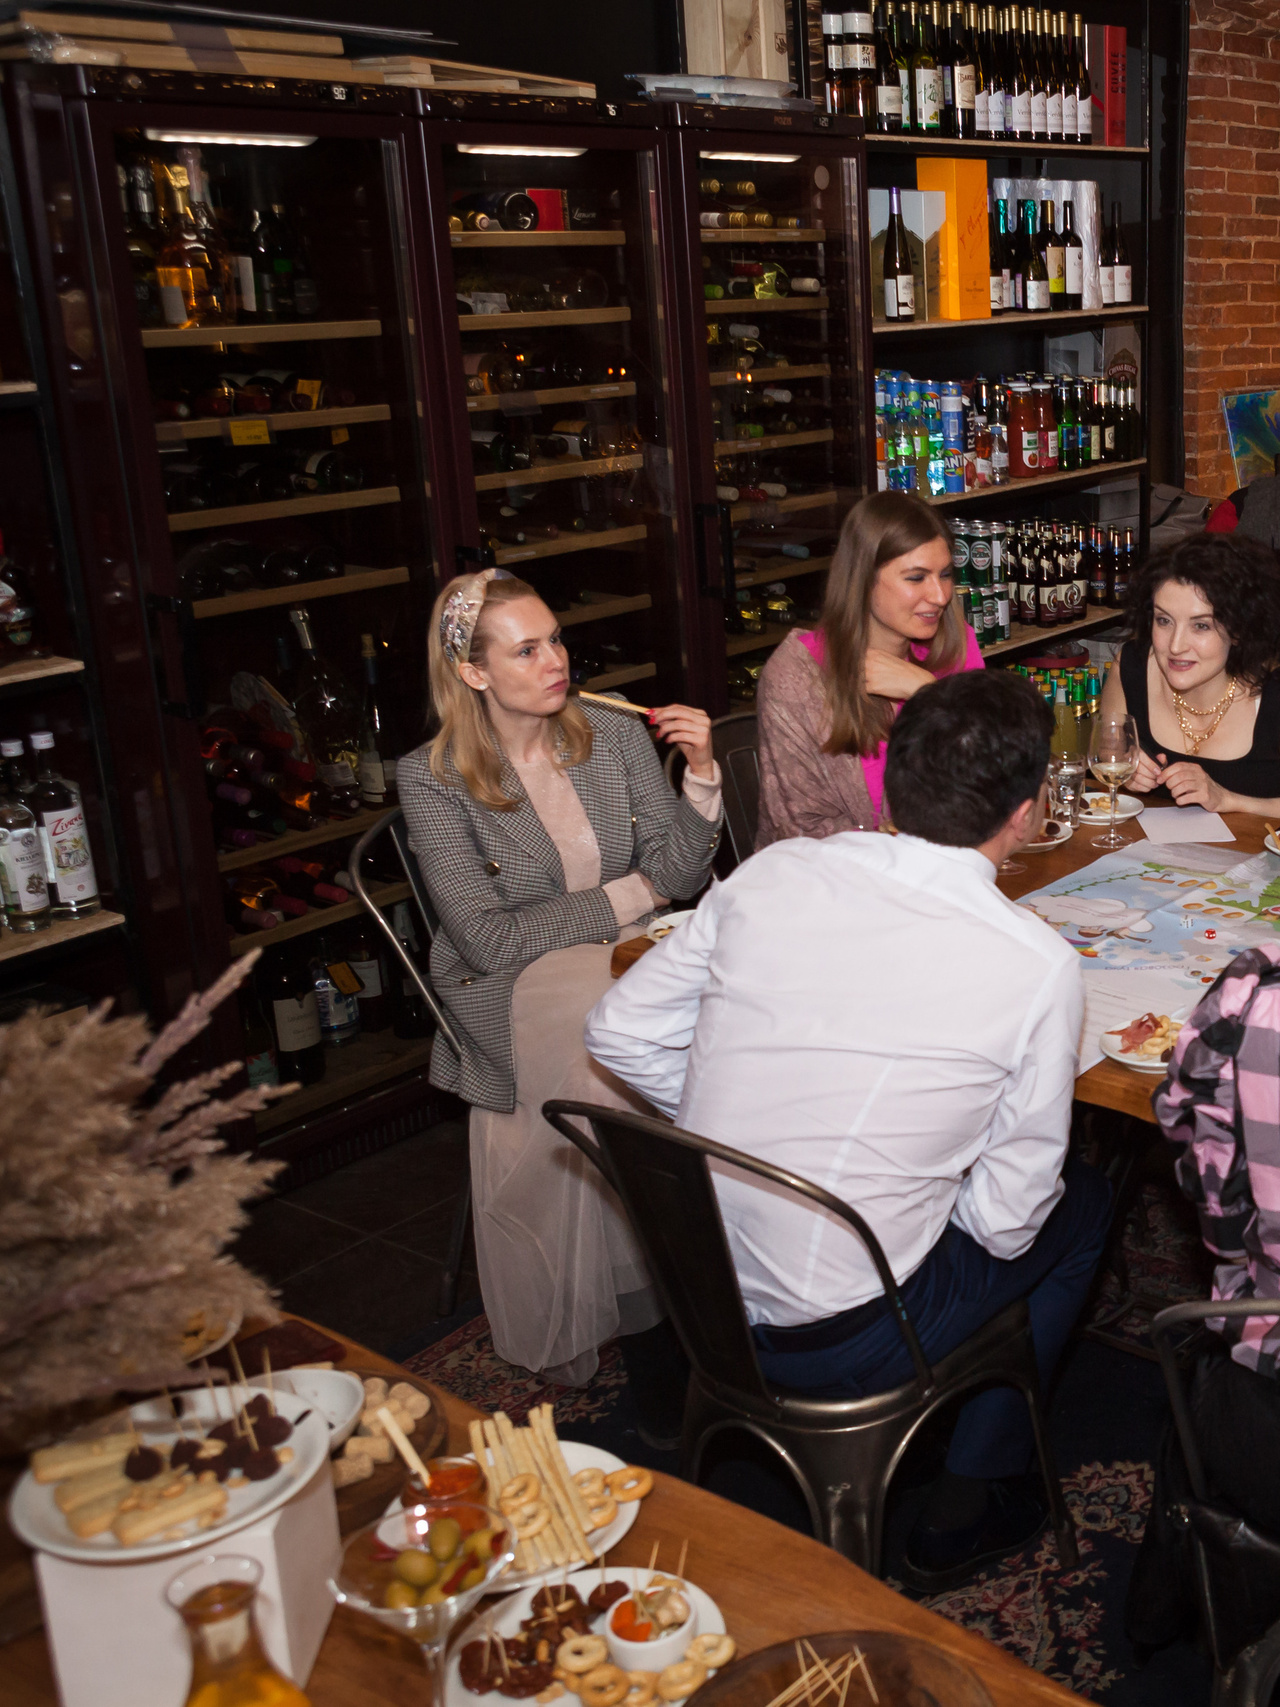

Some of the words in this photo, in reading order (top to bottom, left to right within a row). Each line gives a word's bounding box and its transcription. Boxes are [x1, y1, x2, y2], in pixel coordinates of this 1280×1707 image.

[1108, 364, 1124, 376] CHIVAS
[1123, 364, 1137, 375] REGAL
[966, 411, 976, 450] Rich
